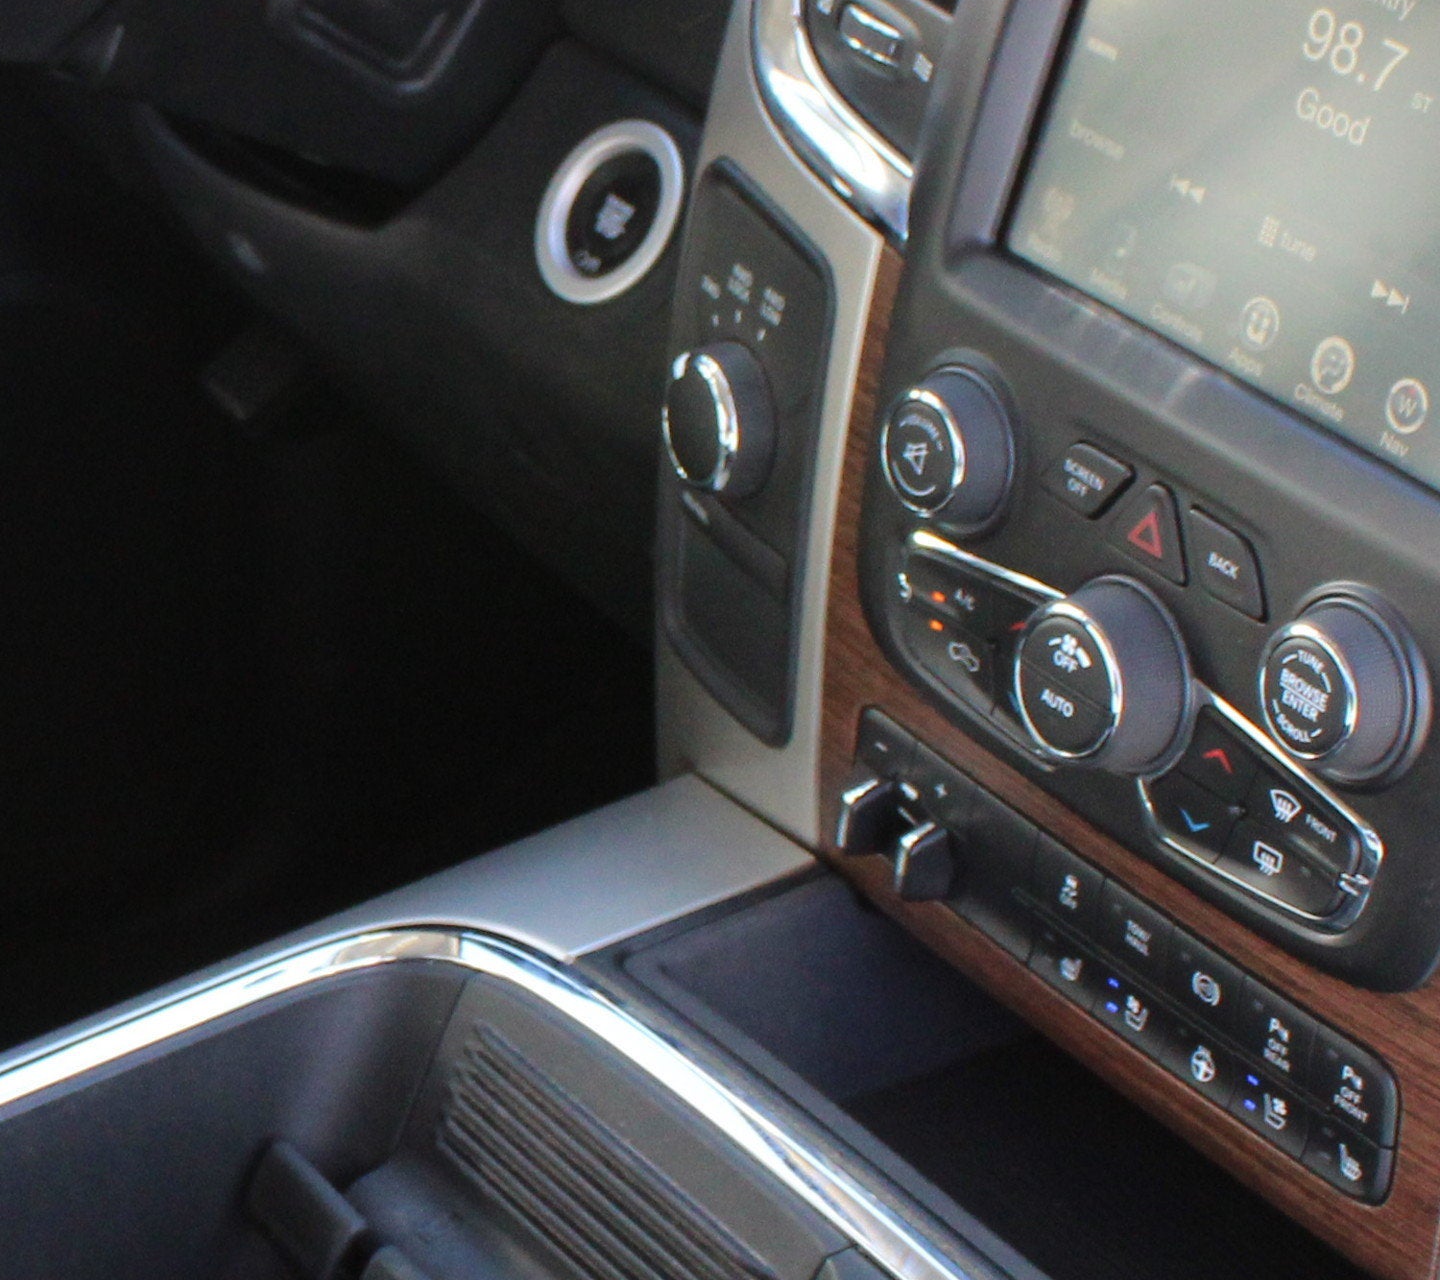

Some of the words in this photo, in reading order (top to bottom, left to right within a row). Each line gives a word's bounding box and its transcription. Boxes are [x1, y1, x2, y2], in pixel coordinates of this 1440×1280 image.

[1302, 6, 1411, 92] 98.7
[1296, 86, 1372, 146] Good
[1280, 231, 1317, 262] tune
[1228, 346, 1265, 377] Apps
[1293, 382, 1346, 422] Climate
[1380, 431, 1410, 458] Nav
[1063, 458, 1106, 491] SCREEN
[1066, 478, 1088, 496] OFF
[1207, 551, 1240, 580] BACK
[1052, 649, 1078, 673] OFF
[1296, 648, 1325, 676] TUNE
[1279, 667, 1330, 707] BROWSE
[1040, 688, 1075, 718] AUTO
[1281, 691, 1319, 722] ENTER
[1276, 712, 1312, 743] SCROLL
[1304, 813, 1337, 843] FRONT
